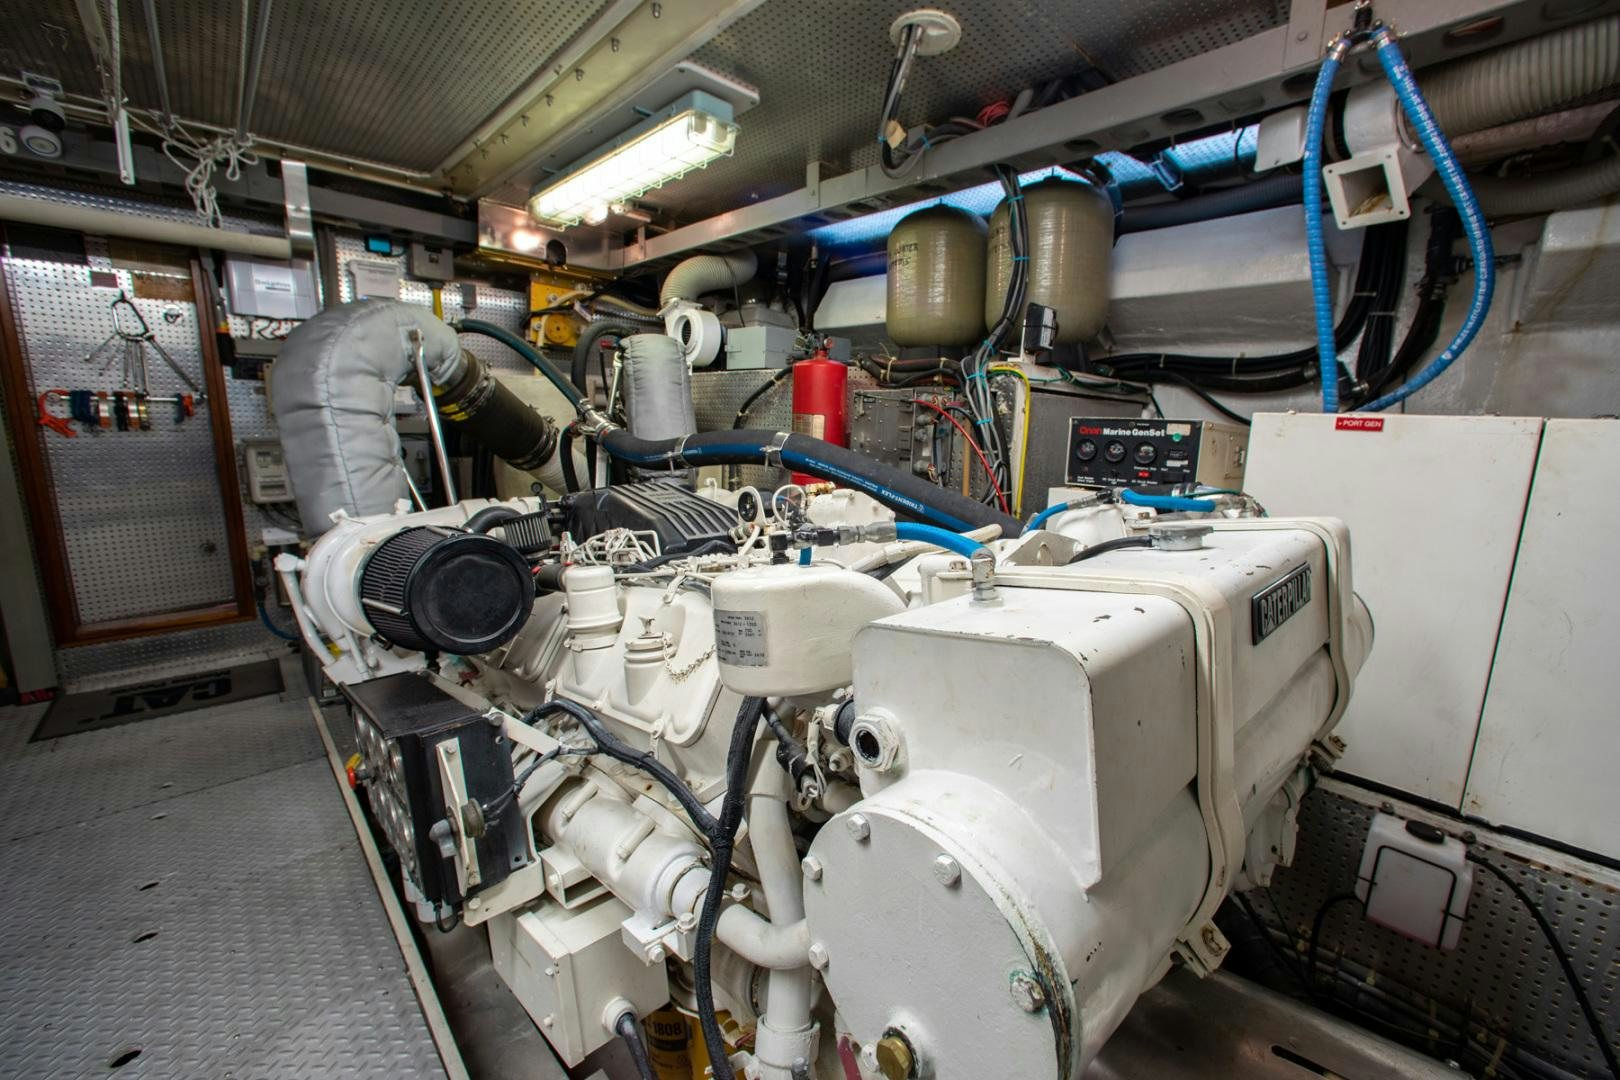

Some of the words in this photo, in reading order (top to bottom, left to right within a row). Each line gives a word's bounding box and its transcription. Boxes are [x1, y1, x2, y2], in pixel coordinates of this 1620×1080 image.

[1343, 419, 1364, 428] PORT
[1364, 420, 1383, 428] GEN
[1103, 427, 1131, 437] Marine
[1132, 428, 1165, 438] GenSet
[1261, 569, 1312, 638] CATERPILLAR
